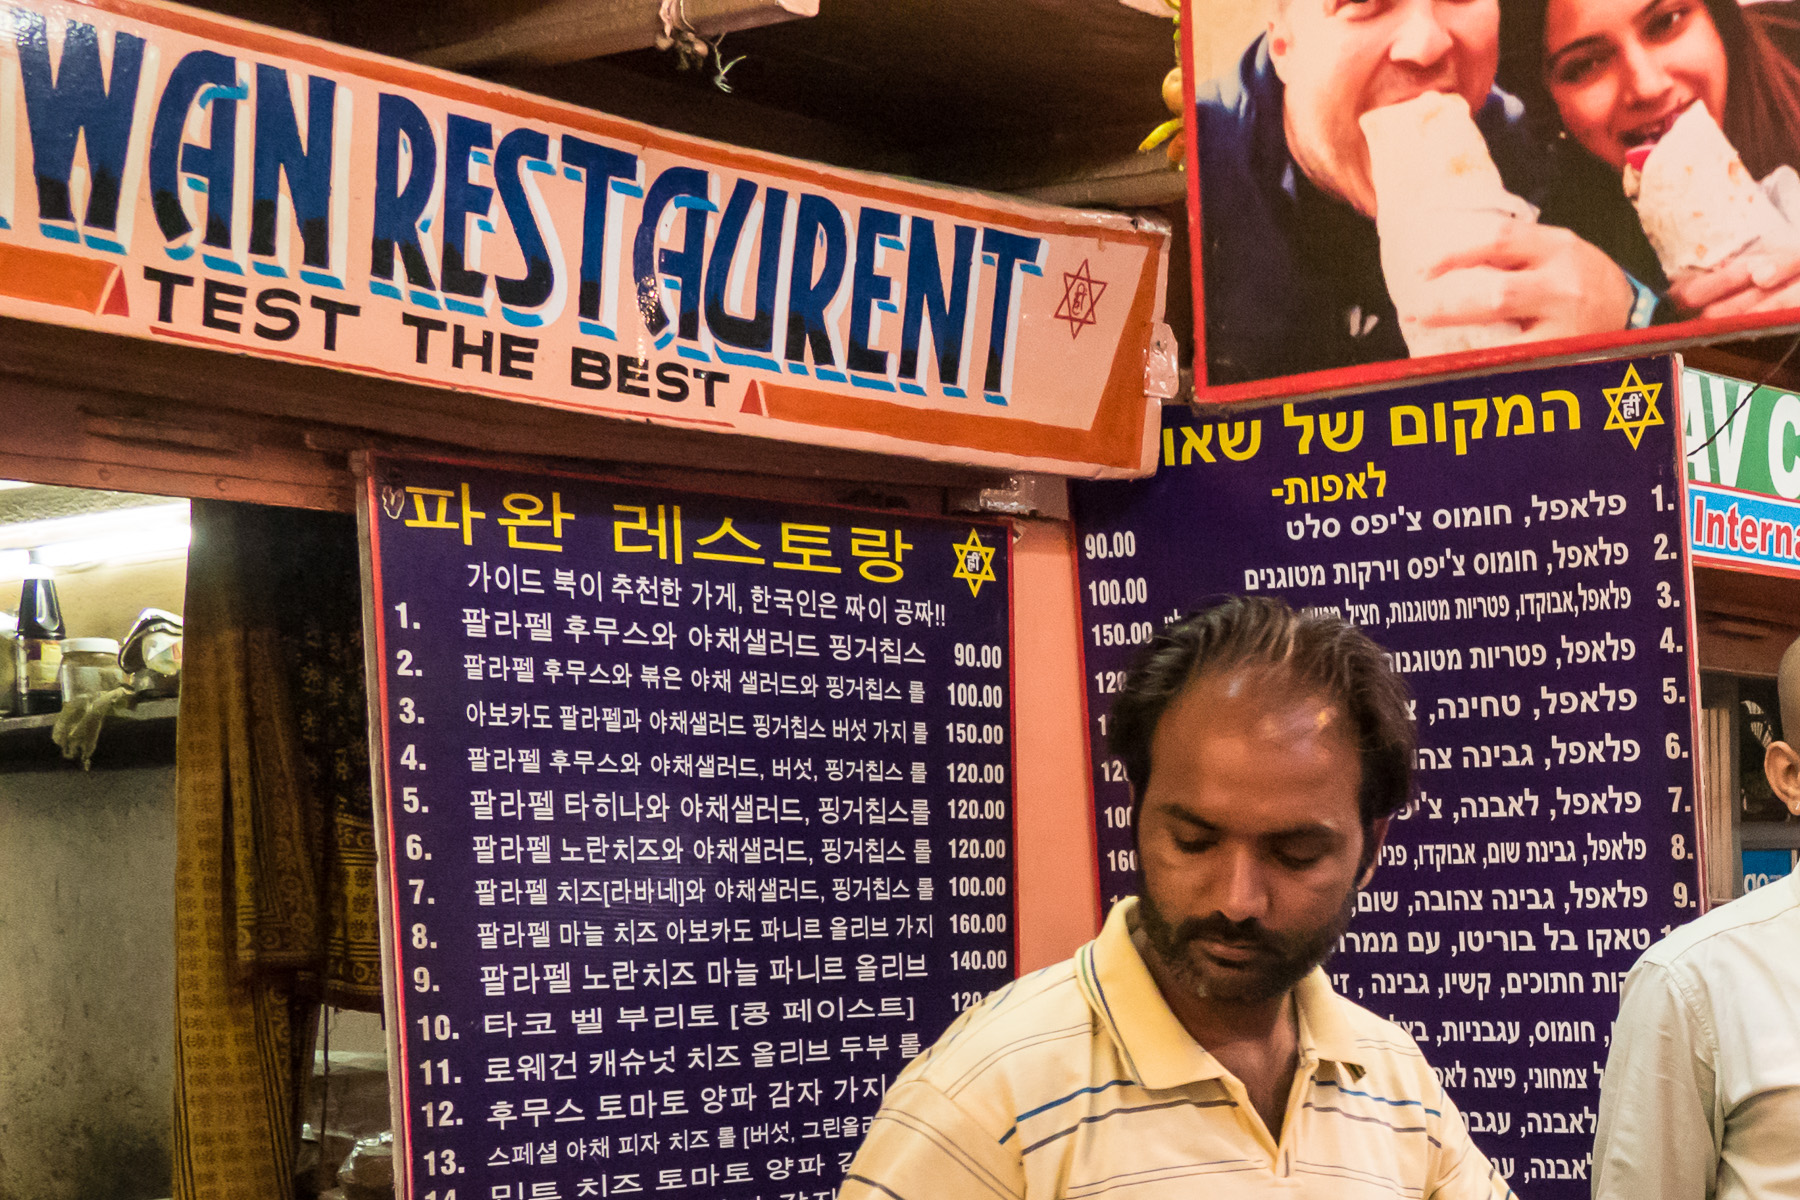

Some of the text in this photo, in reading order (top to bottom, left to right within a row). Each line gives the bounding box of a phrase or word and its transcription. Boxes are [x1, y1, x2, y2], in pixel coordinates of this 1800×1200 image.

[370, 92, 1044, 407] RESTAURENT
[144, 262, 729, 414] TEST THE BEST
[1283, 403, 1364, 454] של
[1390, 390, 1580, 455] המקום
[1525, 490, 1626, 527] פלאפל,
[1652, 485, 1674, 511] 1.
[405, 483, 913, 583] 파완 레스토랑
[1287, 513, 1340, 540] סלט
[1433, 505, 1511, 529] חומוס
[1085, 531, 1135, 559] 90.00
[1474, 550, 1537, 574] חומוס
[1547, 536, 1628, 575] פלאפל,
[1654, 534, 1677, 560] 2.
[1089, 578, 1147, 606] 100.00
[1245, 565, 1325, 590] מטוגנים
[1333, 560, 1399, 590] וירקות
[468, 562, 945, 627] 가이드 북이 추천한 가게, 한국인은 짜이 공짜!!
[1455, 595, 1509, 619] פטריות
[1657, 581, 1679, 608] 3.
[1386, 599, 1450, 629] מטוגנות,
[395, 602, 1001, 668] 1. 팔라펠 후무스와 야채샐러드 핑거칩스 90.00
[1092, 622, 1152, 646] 150.00
[397, 650, 1002, 708] 2. 팔라펠 후무스와 볶은 야채 샐러드와 핑거칩스 롤 100.00
[400, 697, 1003, 744] 3. 아보카도 팔라펠과 야채샐러드 핑거칩스 버섯 가지 롤 150.00
[1414, 832, 1693, 872] 8. פלאפל, גבינת שום, אבוקדו,
[1352, 880, 1695, 917] 9. פלאפל, גבינה צהובה, שום,
[1408, 923, 1650, 957] טאקו בל בוריטו, עם
[414, 950, 1006, 996] 9. 팔라펠 노란치즈 마늘 파니르 올리브 140.00
[1372, 972, 1584, 1000] חתוכים, קשיו, גבינה
[418, 997, 914, 1040] 10. 타코 벨 부리토 [콩 페이스트]
[1437, 1021, 1595, 1047] חומוס, עגבניות,
